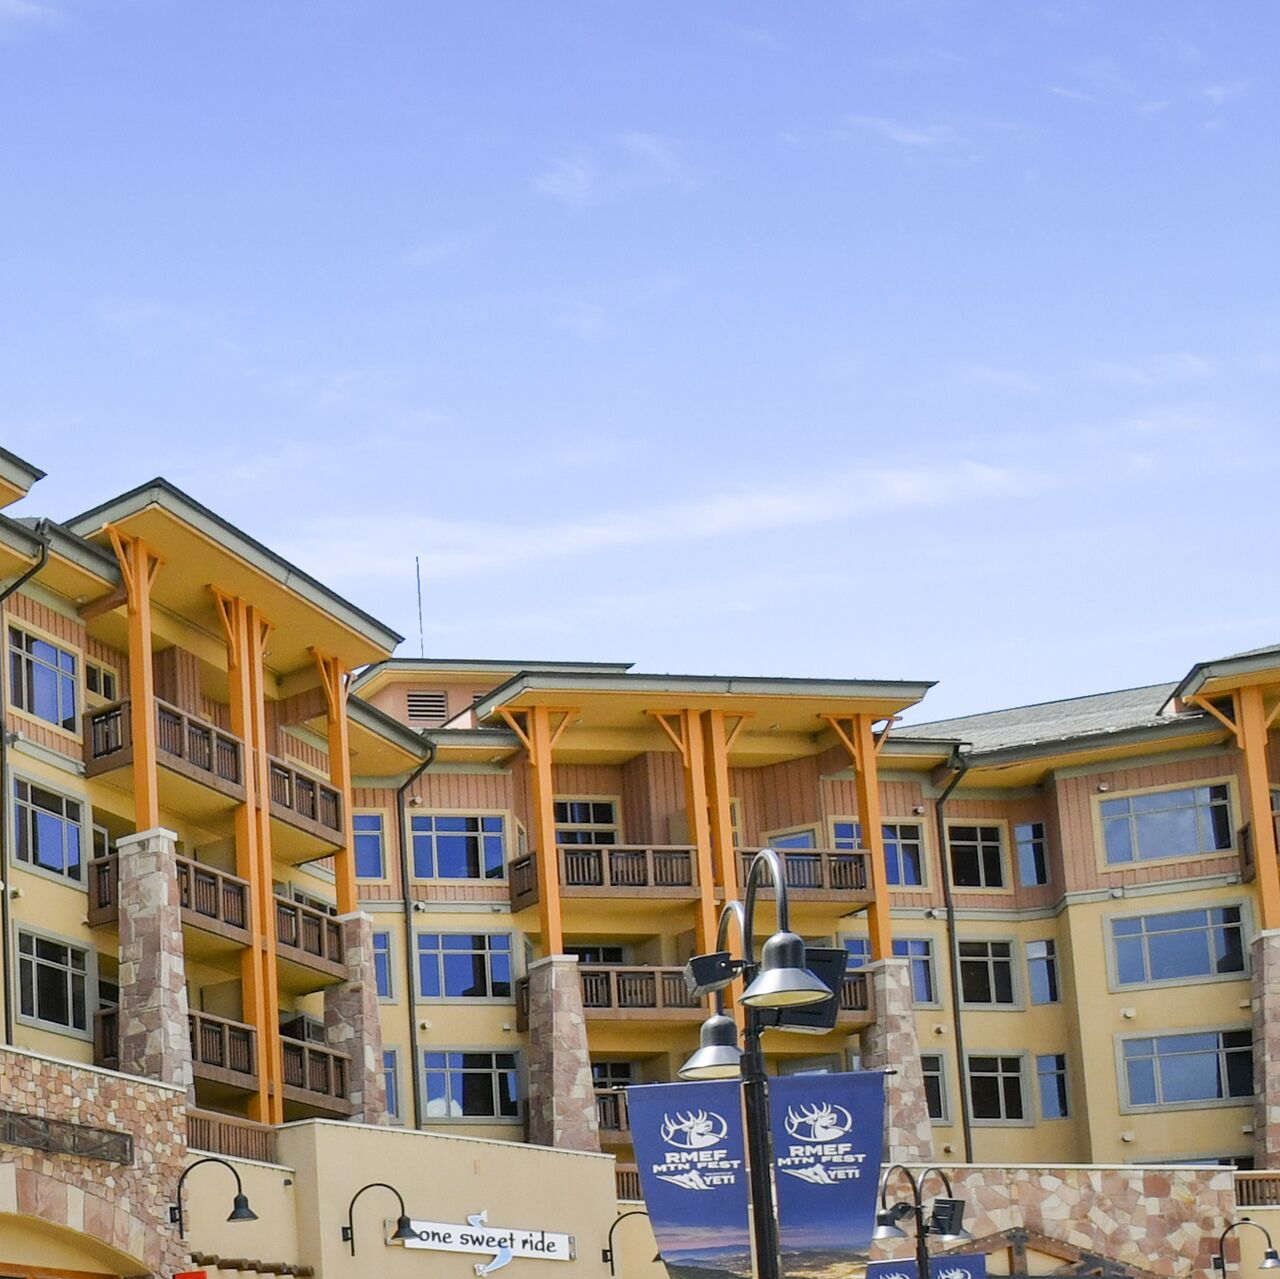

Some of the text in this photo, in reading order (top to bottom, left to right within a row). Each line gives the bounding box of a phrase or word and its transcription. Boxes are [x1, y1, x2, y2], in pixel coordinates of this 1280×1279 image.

[664, 1150, 727, 1163] RMEF
[789, 1143, 852, 1157] RMEF
[652, 1160, 741, 1174] MTN FEST
[777, 1154, 866, 1167] MTN FEST
[702, 1175, 736, 1185] YETI
[828, 1169, 860, 1179] YETI
[418, 1229, 557, 1253] one sweet ride
